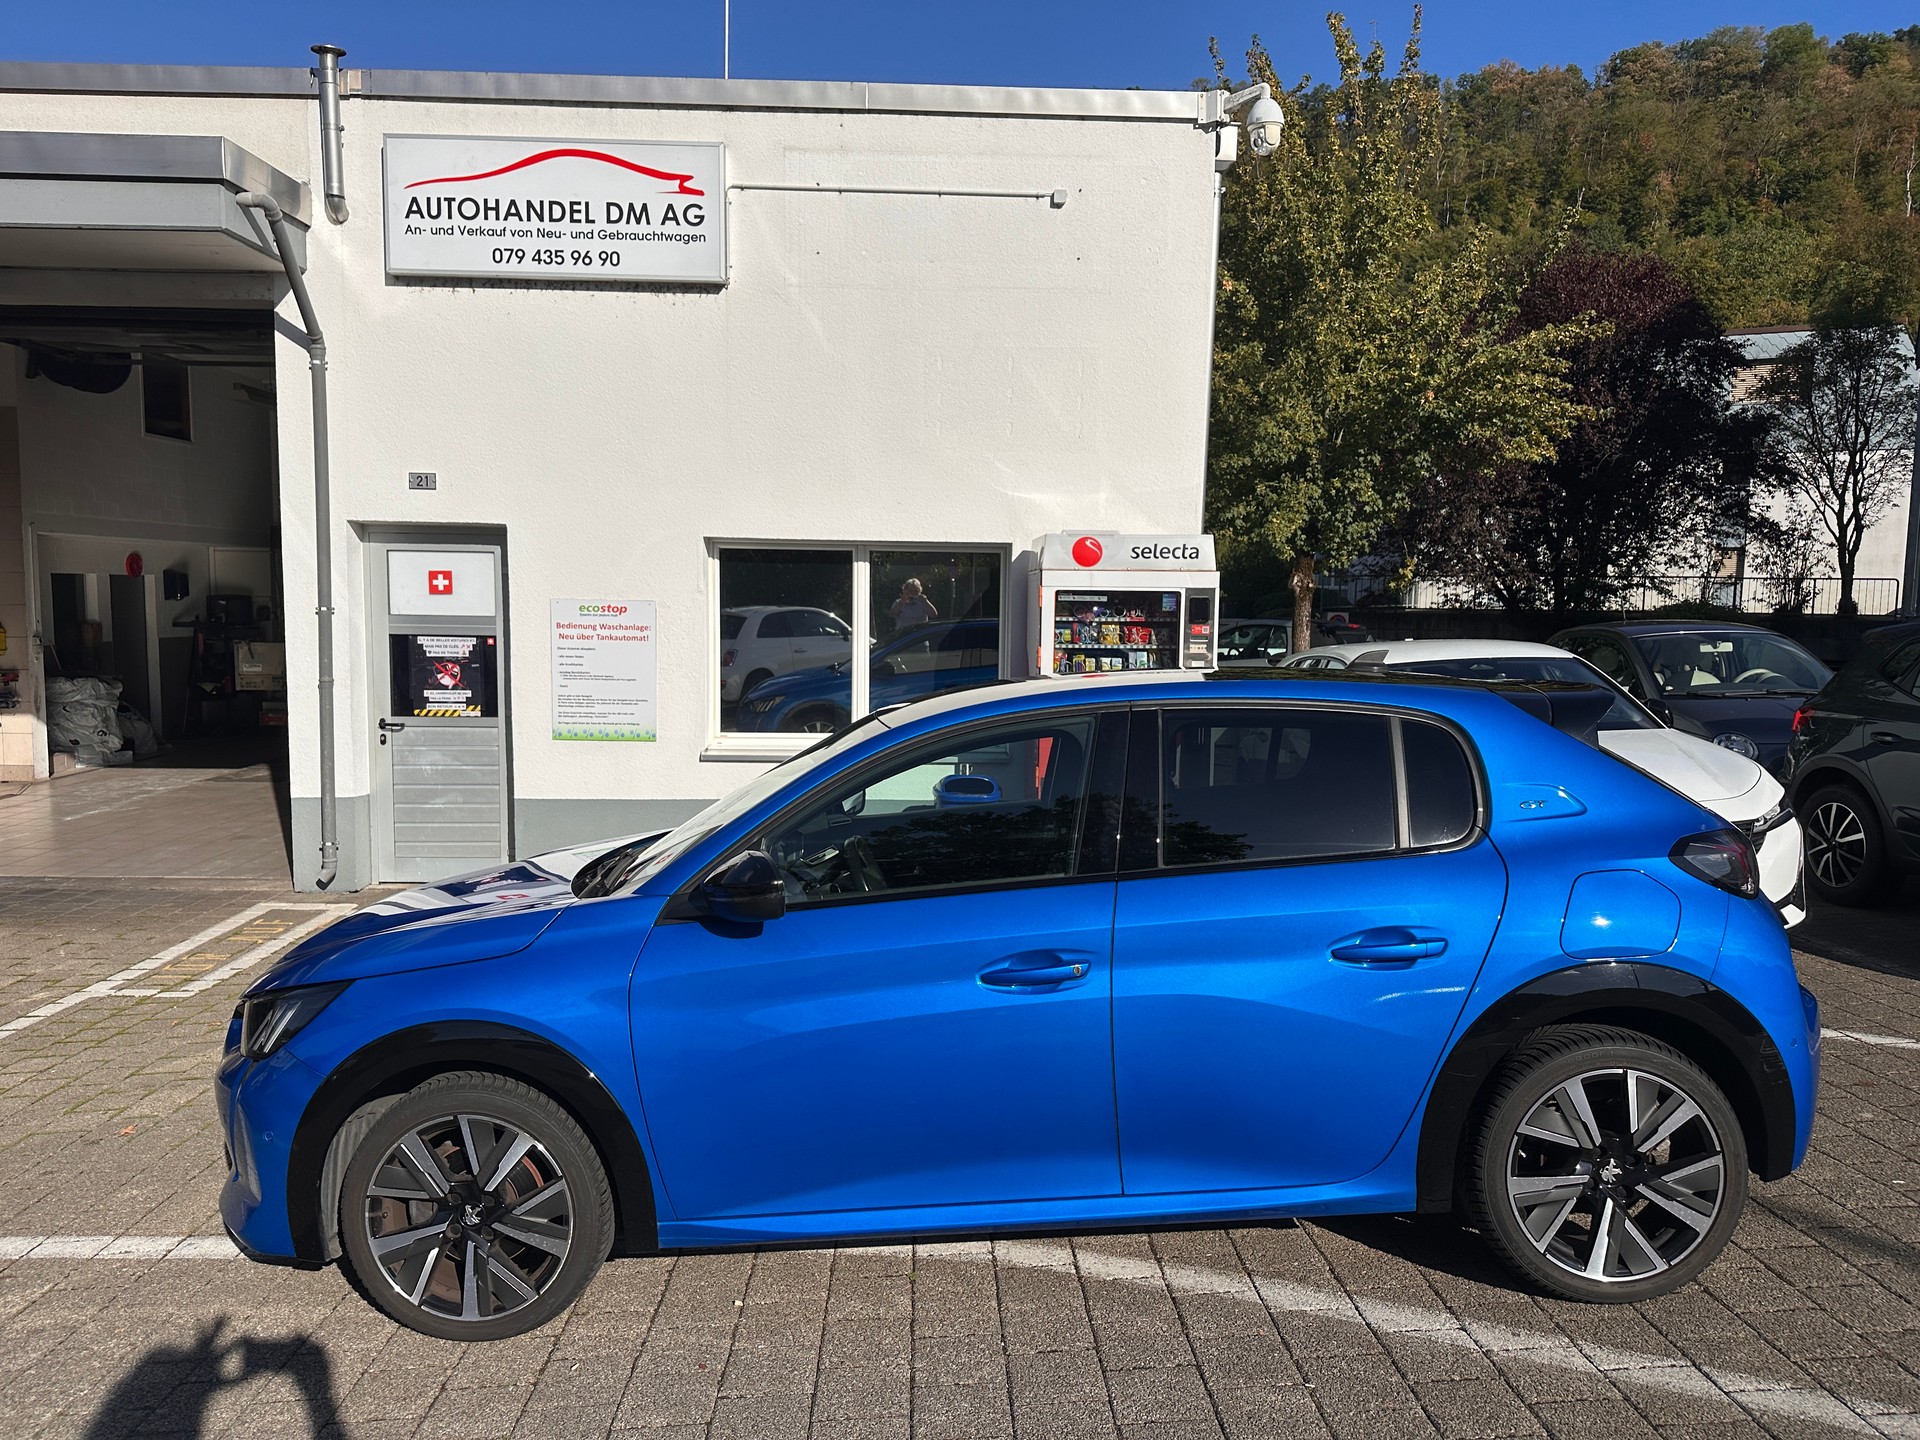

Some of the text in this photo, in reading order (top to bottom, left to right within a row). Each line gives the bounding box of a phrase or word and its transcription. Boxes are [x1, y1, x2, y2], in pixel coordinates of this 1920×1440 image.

[404, 196, 706, 227] AUTOHANDEL DM AG
[404, 224, 707, 245] An- und Verkauf von Neu- und Gebrauchtwagen
[492, 248, 621, 267] 079 435 96 90
[416, 475, 428, 487] 21
[1130, 543, 1200, 559] selecta
[578, 604, 628, 615] ecostop
[556, 622, 652, 632] Bedienung Waschanlage:
[596, 634, 649, 642] Tankautomat!
